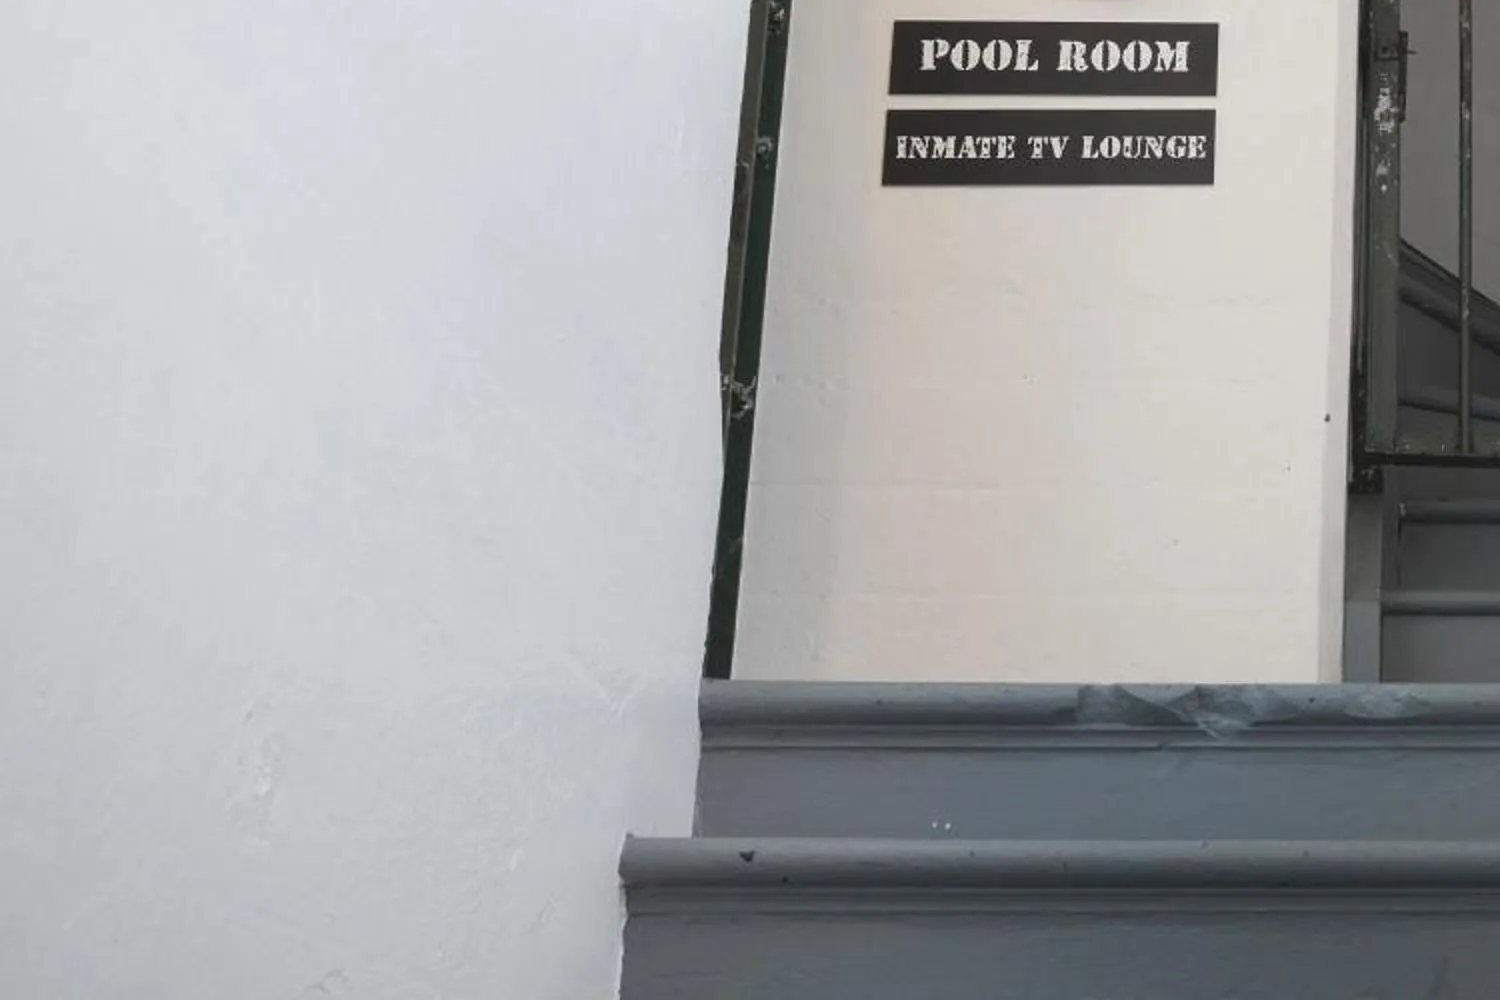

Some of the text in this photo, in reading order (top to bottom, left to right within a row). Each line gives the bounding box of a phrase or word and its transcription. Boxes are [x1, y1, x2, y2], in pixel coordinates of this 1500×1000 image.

[919, 38, 1191, 72] POOL ROOM
[895, 135, 1208, 159] INMATE TV LOUNGE
